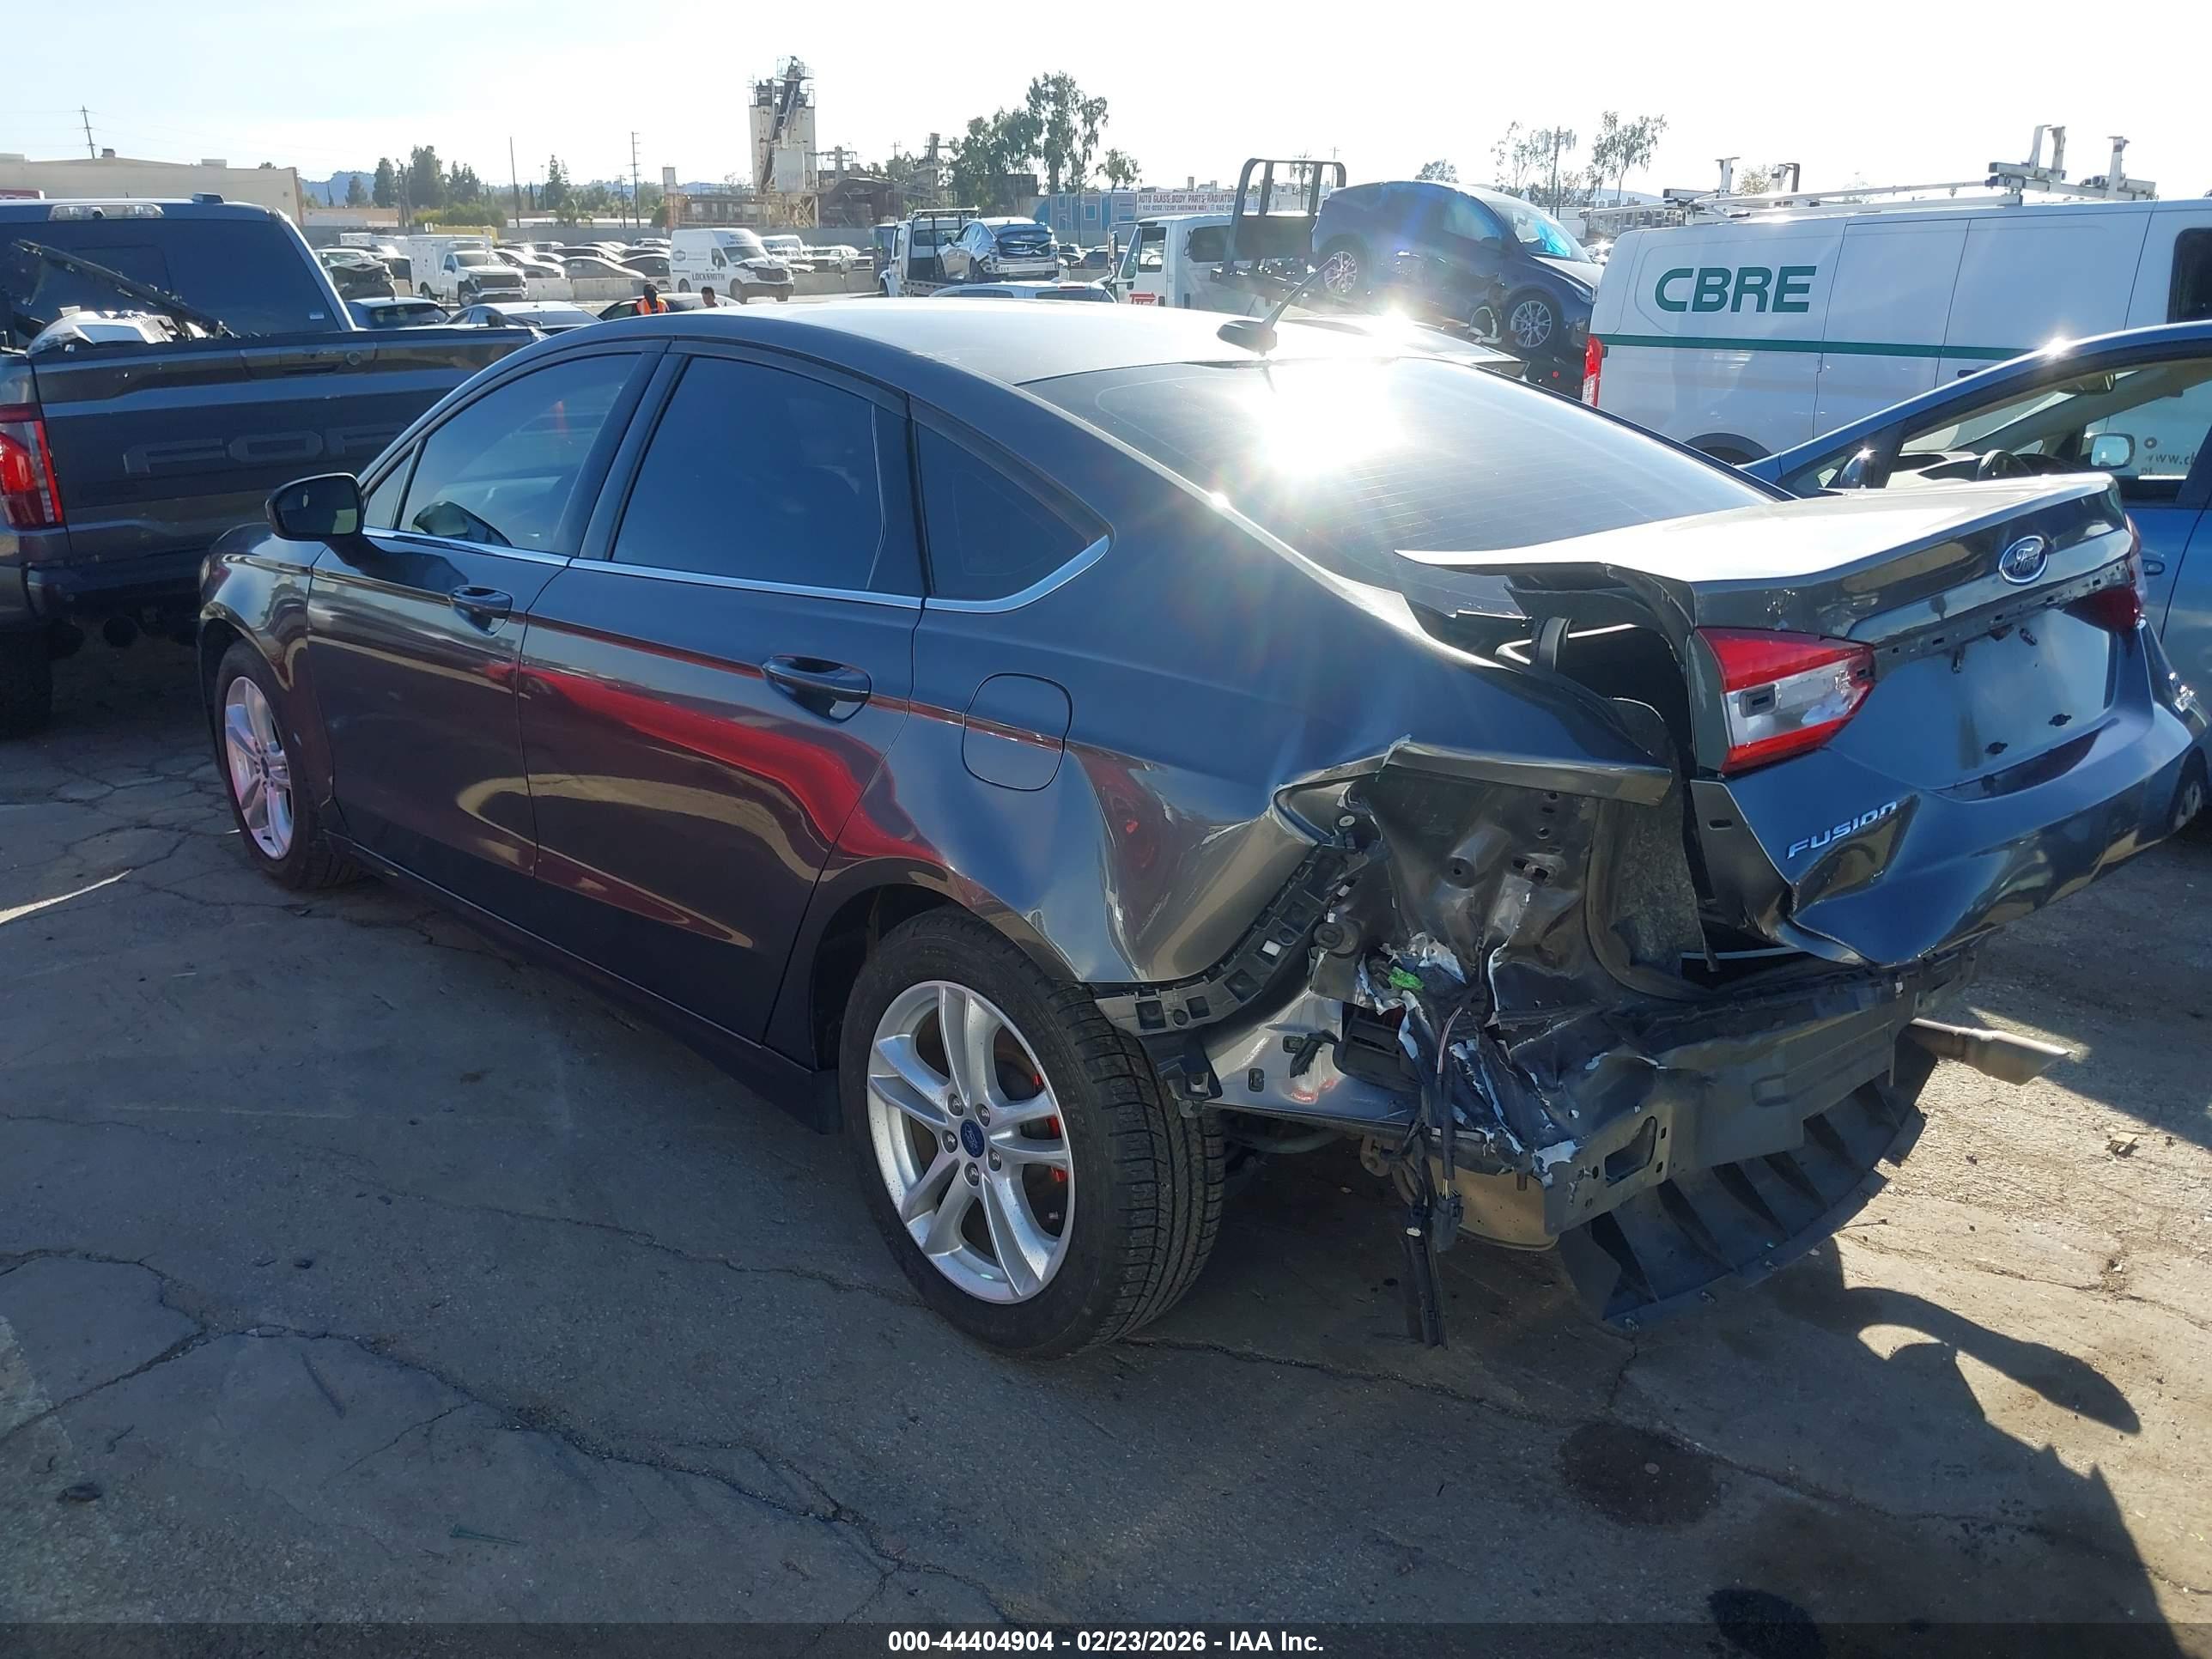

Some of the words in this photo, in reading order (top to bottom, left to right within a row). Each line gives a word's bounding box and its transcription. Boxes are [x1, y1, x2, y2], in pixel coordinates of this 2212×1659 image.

[1139, 194, 1152, 203] AUTO
[1655, 265, 1817, 313] CBRE
[123, 422, 408, 474] FOR
[1786, 800, 1897, 859] FUSION
